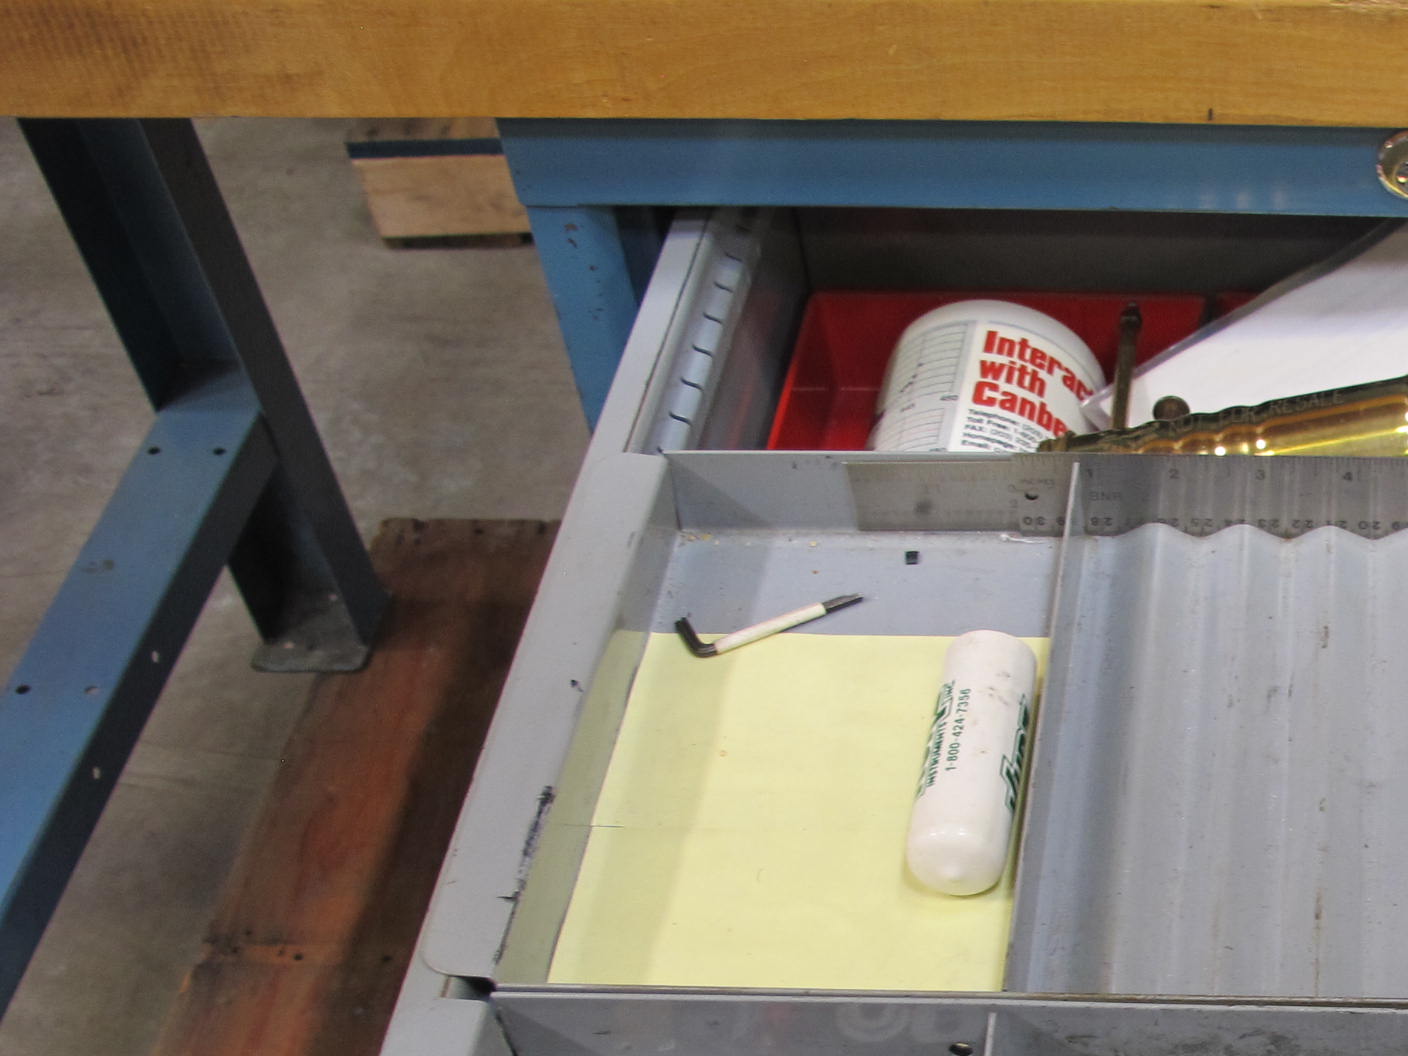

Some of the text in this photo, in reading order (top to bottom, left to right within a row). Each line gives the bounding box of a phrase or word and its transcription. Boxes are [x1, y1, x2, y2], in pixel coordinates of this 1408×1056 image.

[979, 359, 1047, 398] with
[1169, 468, 1180, 480] 2
[1255, 469, 1266, 481] 3
[1342, 471, 1353, 482] 4
[944, 687, 972, 772] 1-800-424-7356
